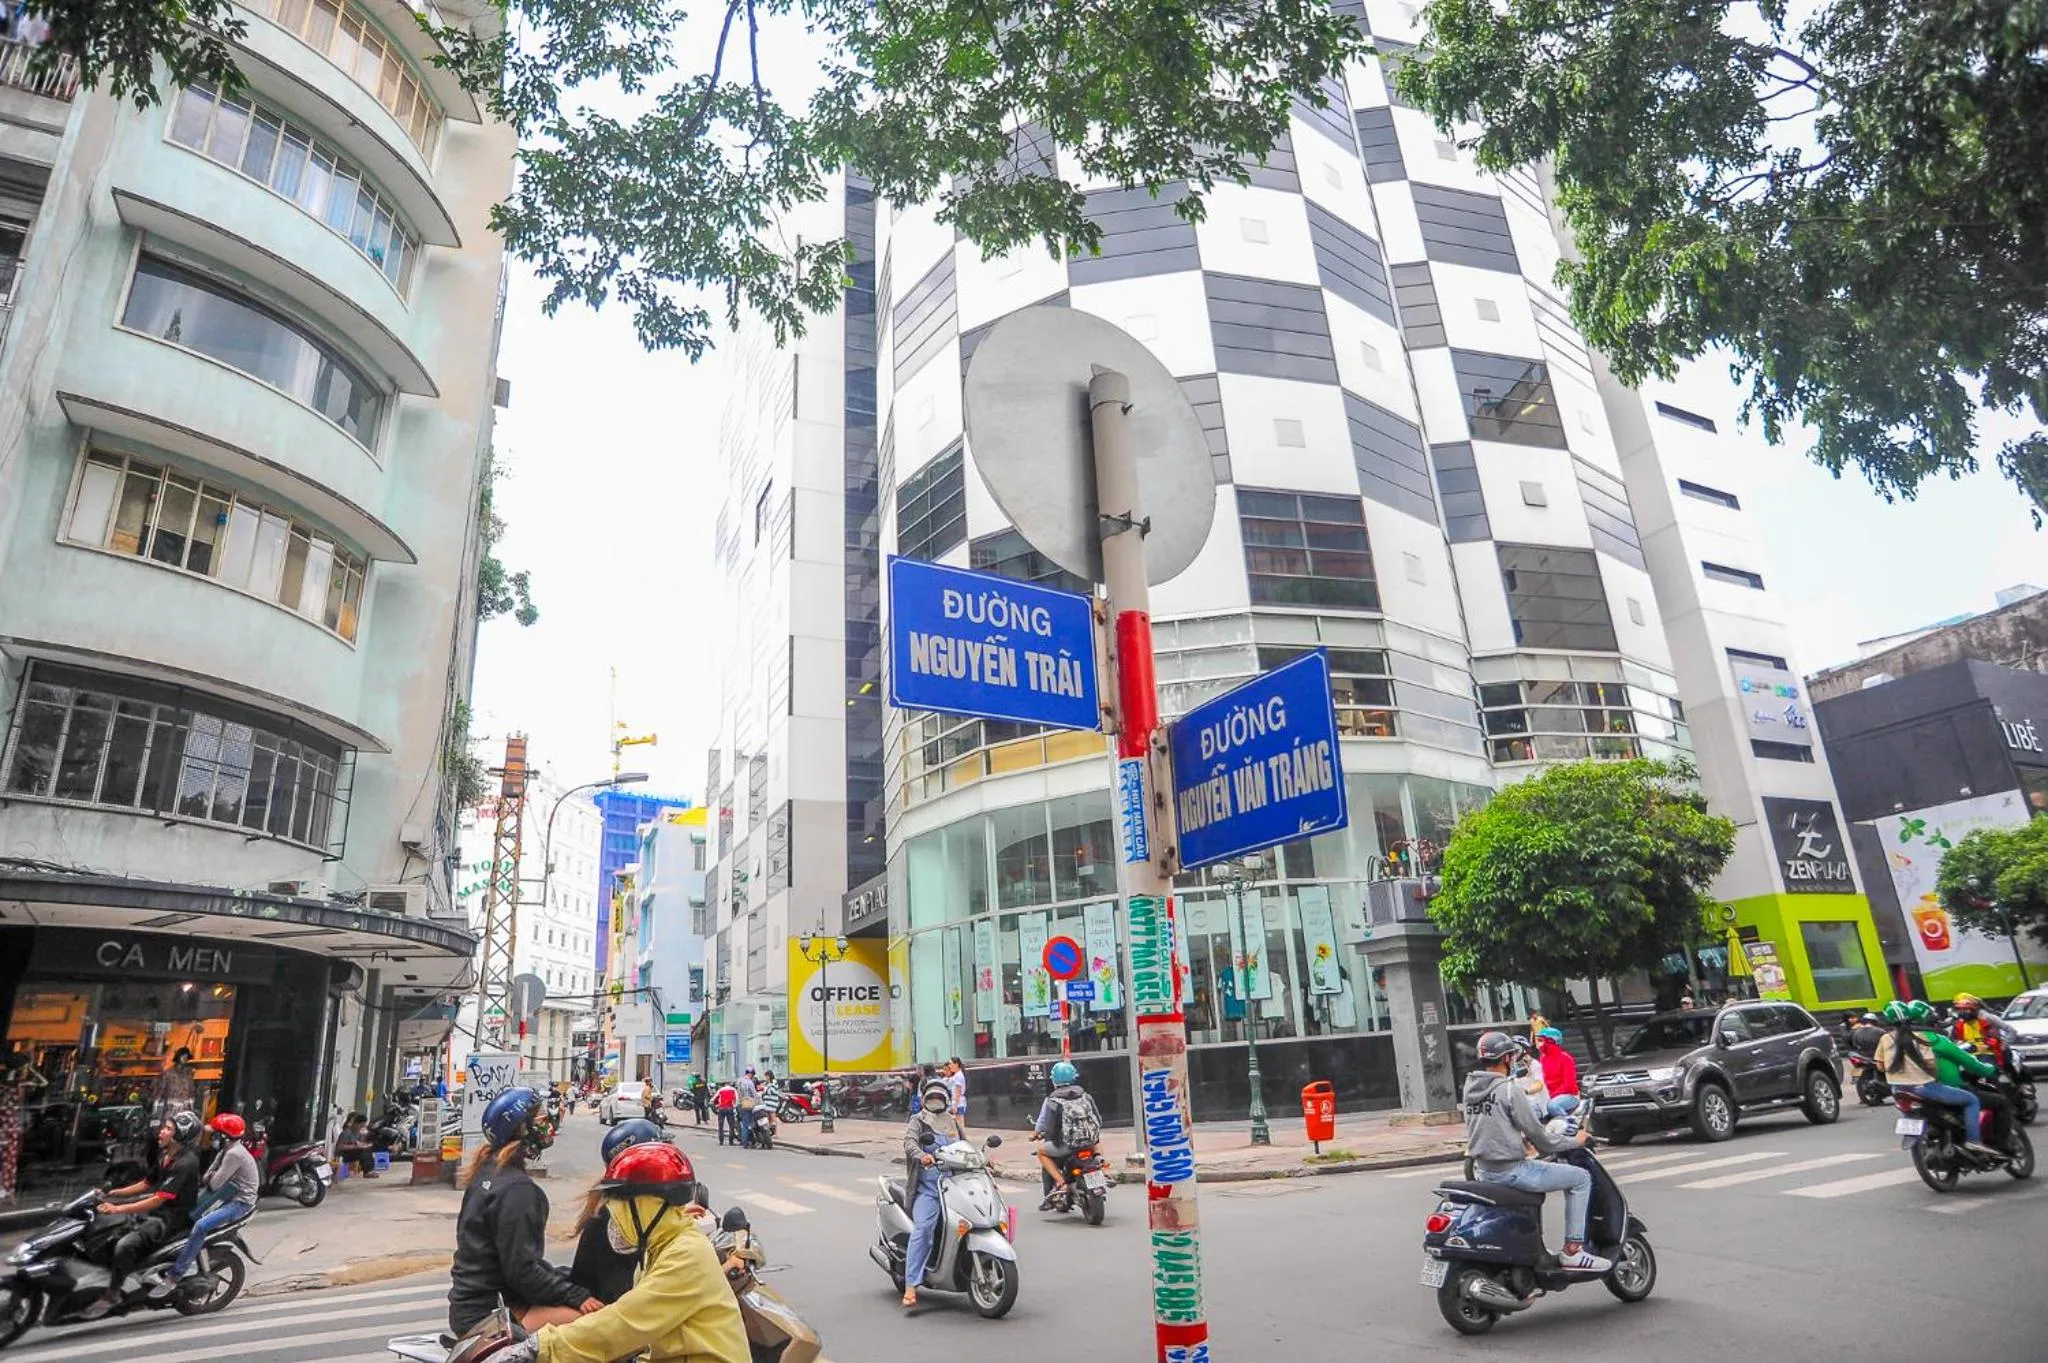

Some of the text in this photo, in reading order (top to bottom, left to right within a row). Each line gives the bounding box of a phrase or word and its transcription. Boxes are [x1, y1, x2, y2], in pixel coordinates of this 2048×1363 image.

[943, 589, 1052, 637] ĐƯỜNG
[909, 631, 1083, 698] NGUYỄN TRÃI
[1201, 696, 1286, 761] ĐƯỜNG
[1179, 763, 1232, 834] NGUYỄN
[1233, 757, 1268, 814] VĂN
[1269, 737, 1333, 802] TRÁNG
[457, 878, 524, 899] MASAGE
[96, 941, 232, 974] CA MEN
[811, 986, 880, 1001] OFFICE
[836, 1004, 880, 1016] LEASE
[1466, 1103, 1493, 1116] GEAR
